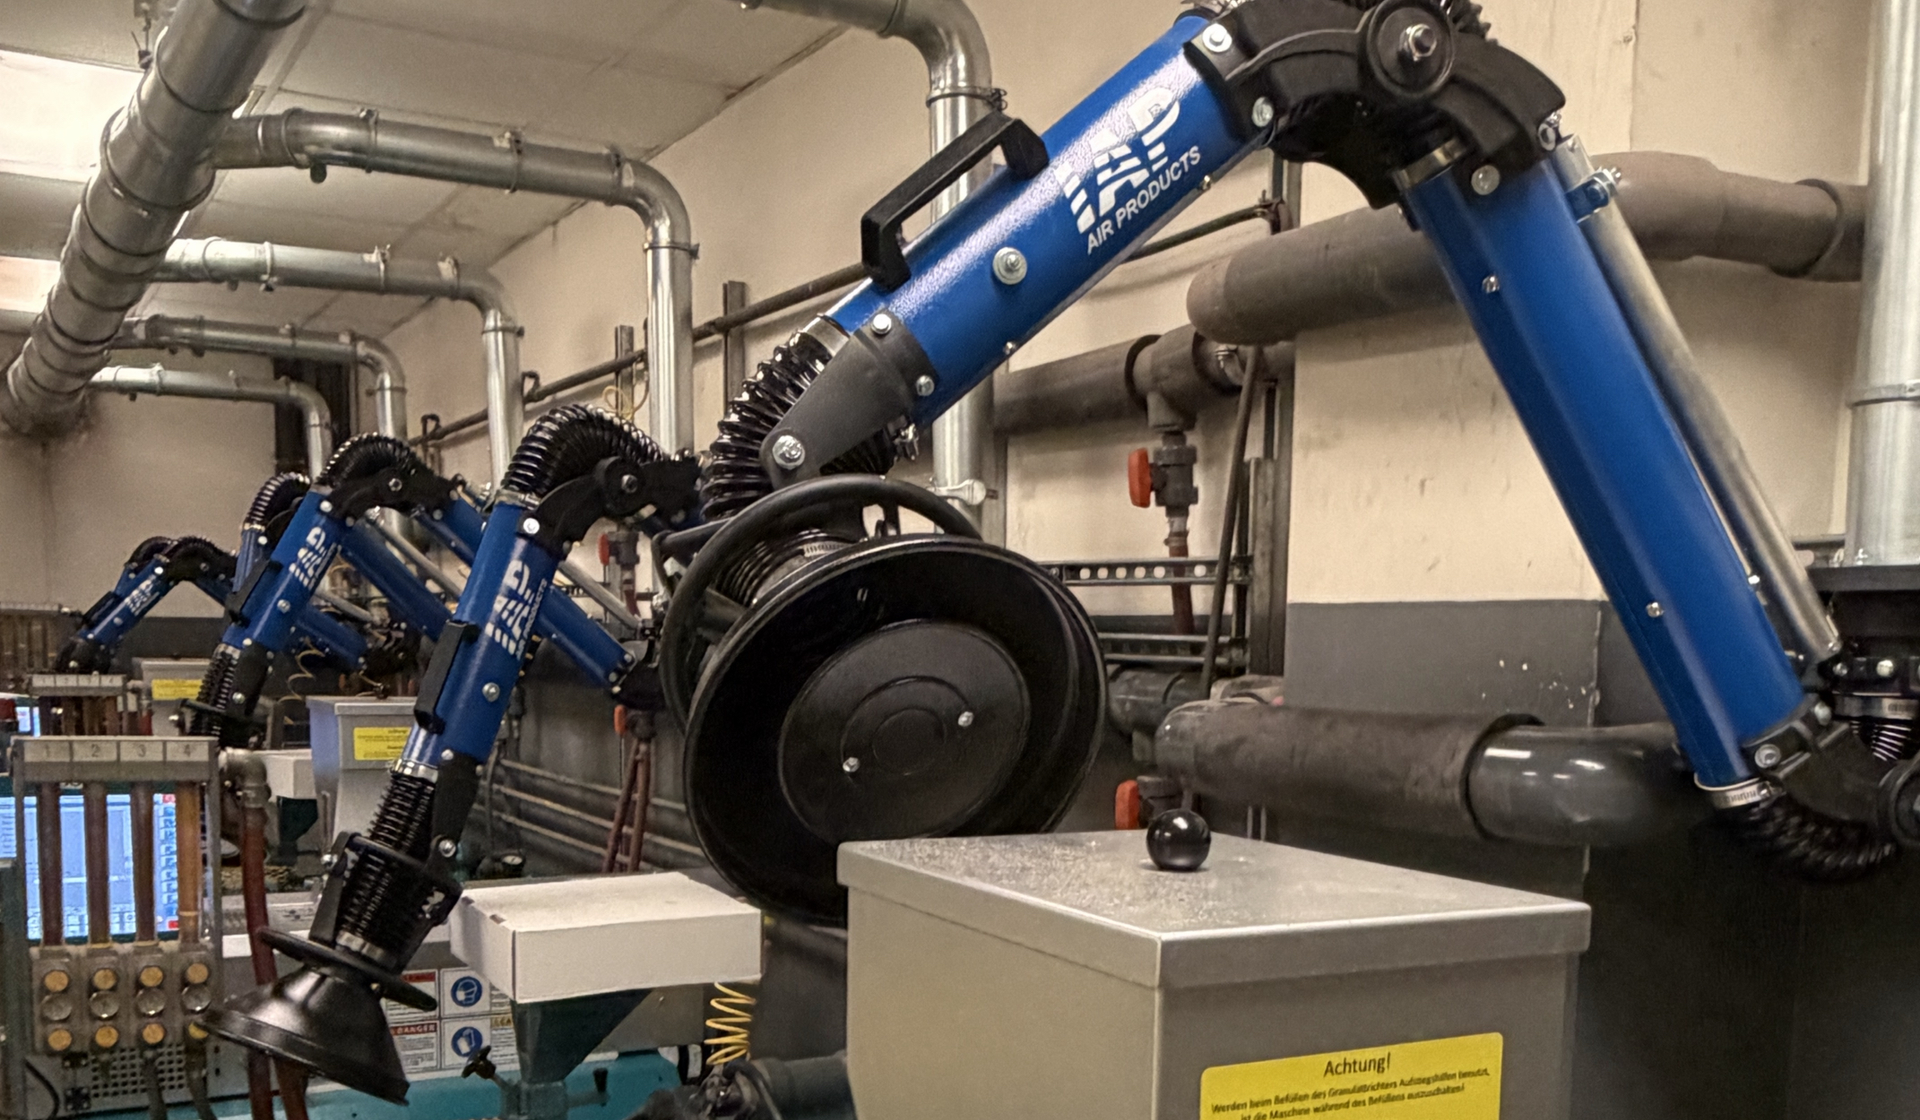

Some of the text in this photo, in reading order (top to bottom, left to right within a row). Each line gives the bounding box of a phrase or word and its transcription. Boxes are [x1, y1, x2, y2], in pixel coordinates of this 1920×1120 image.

[1087, 144, 1202, 255] AIR PRODUCTS
[91, 743, 101, 758] 2
[137, 743, 147, 758] 3
[183, 743, 191, 758] 4
[396, 1023, 436, 1035] DANGER
[1323, 1051, 1391, 1078] Achtung!
[1211, 1100, 1248, 1114] Werden
[1269, 1106, 1311, 1120] Maschine
